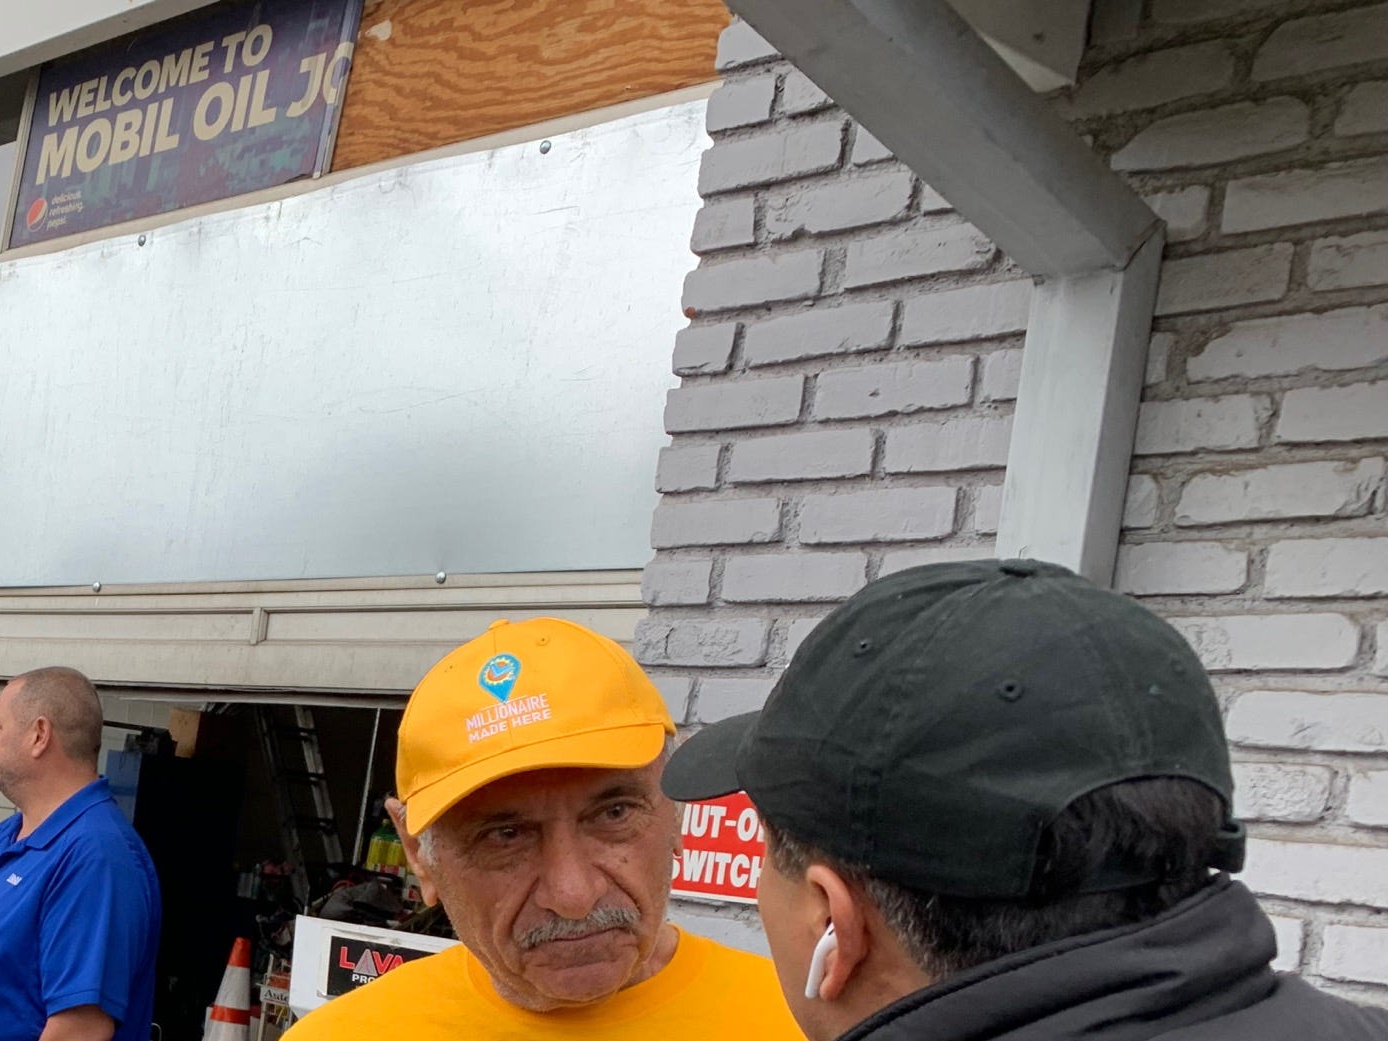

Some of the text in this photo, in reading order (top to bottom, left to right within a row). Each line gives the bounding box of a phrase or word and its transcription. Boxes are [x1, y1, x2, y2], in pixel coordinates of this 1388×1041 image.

[47, 24, 273, 127] WELCOME TO
[35, 97, 179, 185] MOBIL
[193, 70, 277, 141] OIL
[466, 692, 550, 731] MILLIONAIRE
[468, 709, 553, 744] MADE HERE
[681, 804, 764, 843] UT-O
